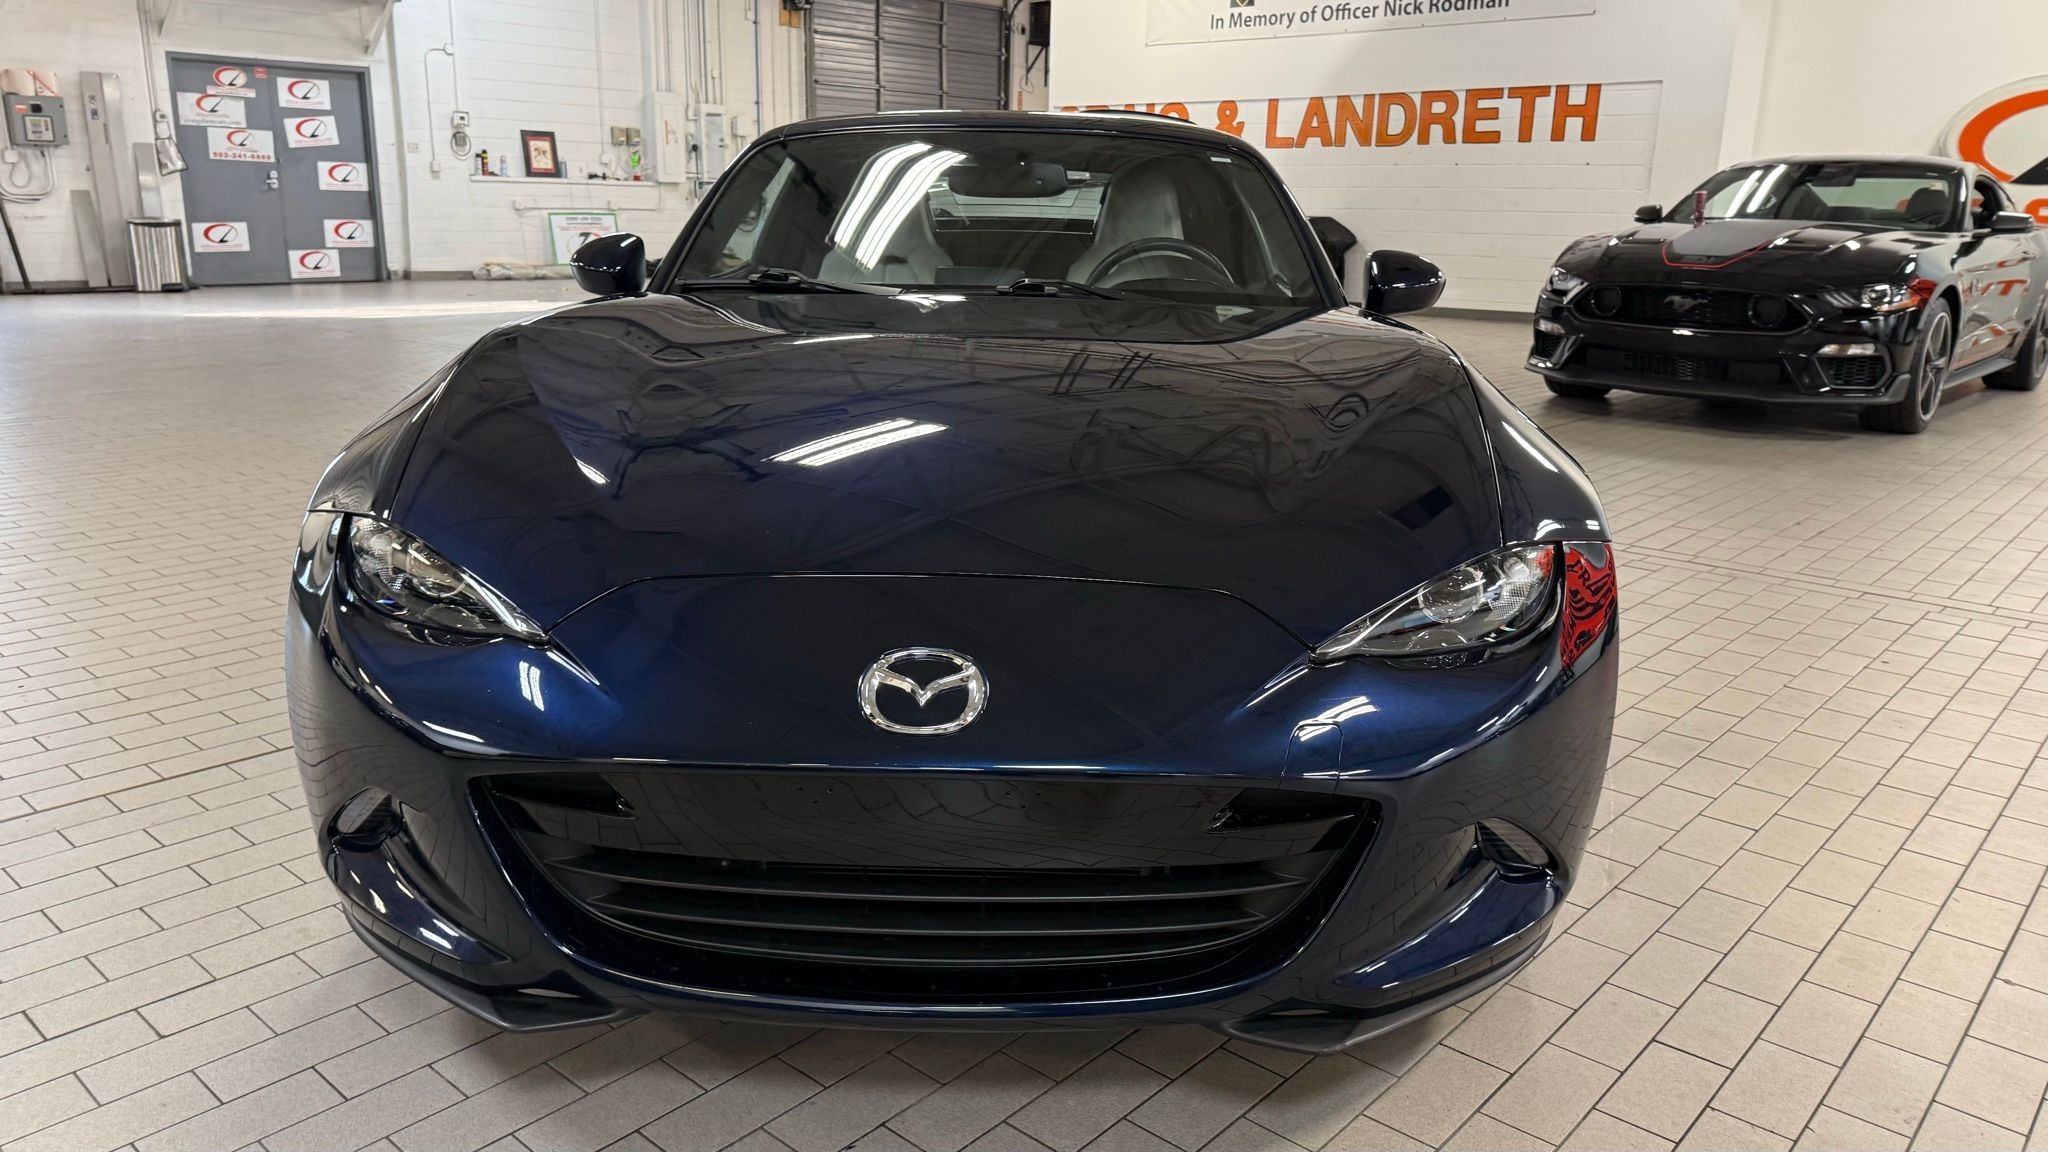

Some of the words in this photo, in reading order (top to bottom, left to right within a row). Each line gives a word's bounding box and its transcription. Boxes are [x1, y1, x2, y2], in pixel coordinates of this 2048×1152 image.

[1210, 14, 1224, 30] In
[1228, 11, 1296, 29] Memory
[1299, 5, 1318, 24] of
[1321, 3, 1379, 22] Officer
[1384, 0, 1424, 17] Nick
[1216, 100, 1245, 138] &
[1265, 84, 1601, 149] LANDRETH
